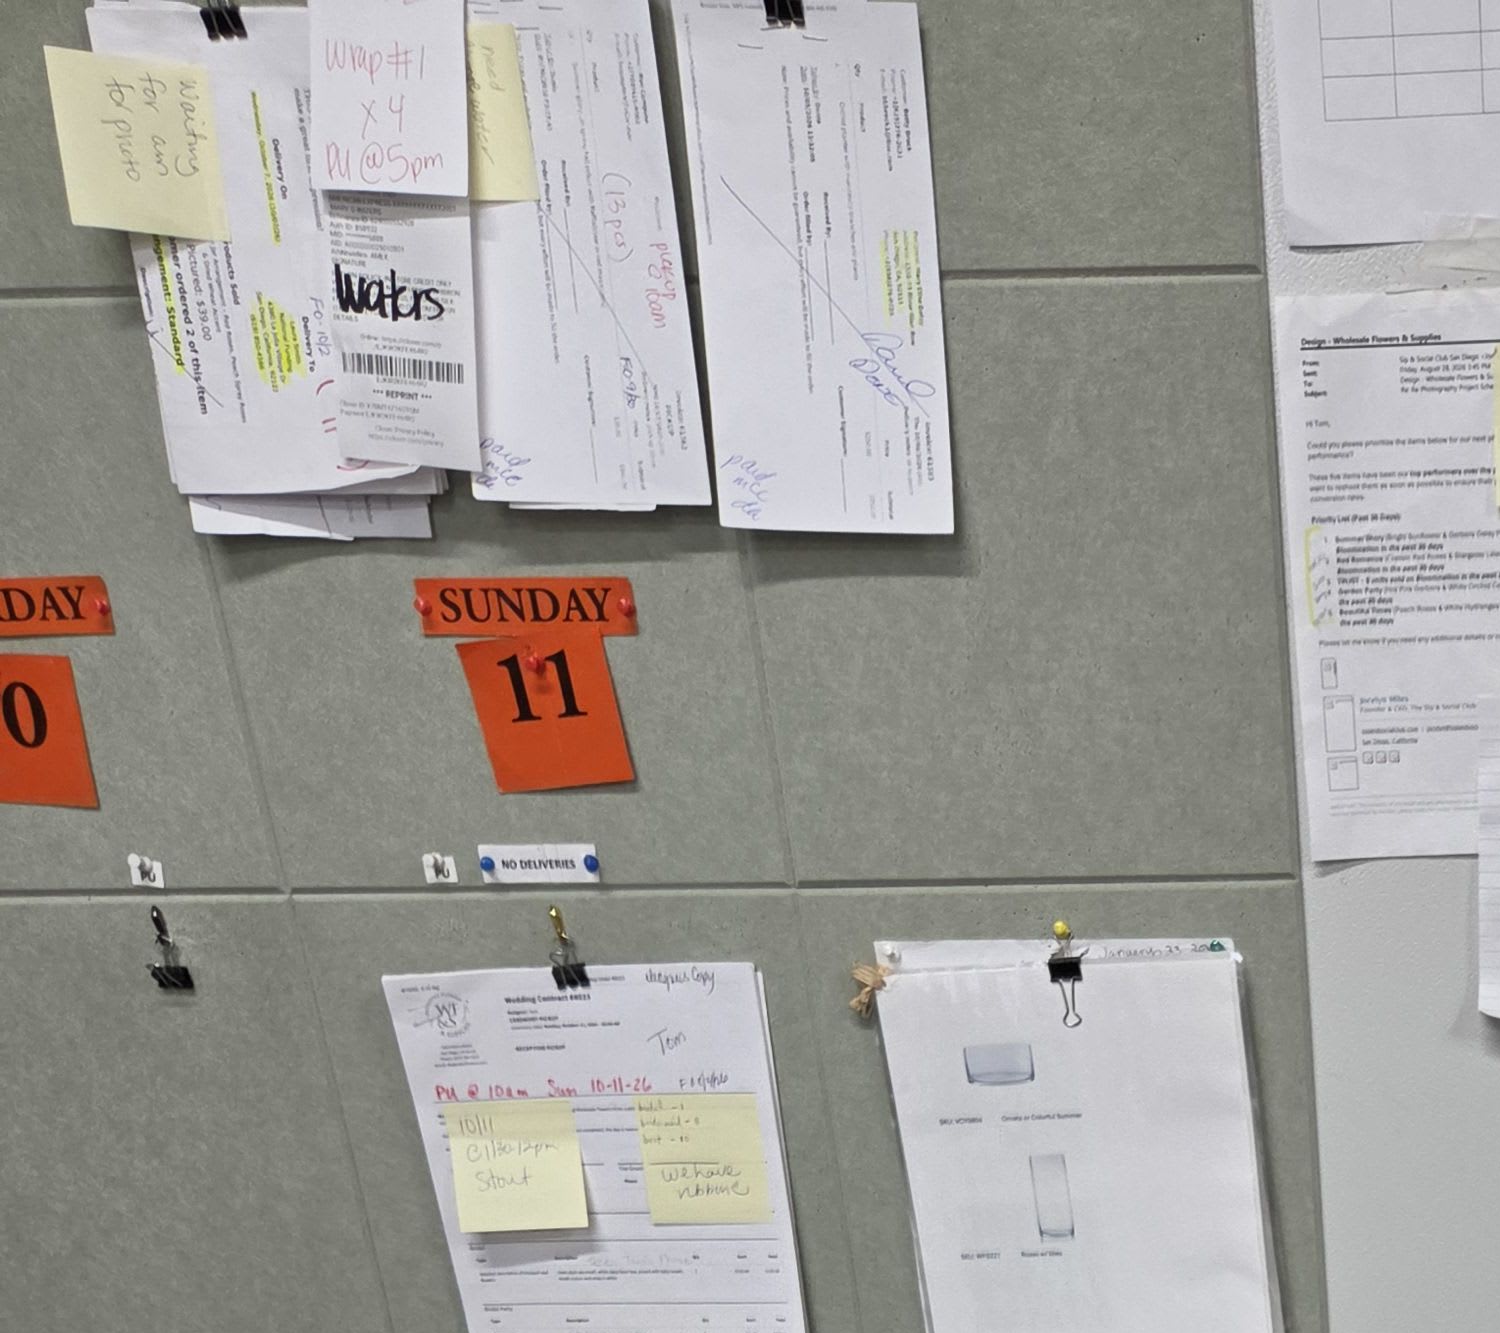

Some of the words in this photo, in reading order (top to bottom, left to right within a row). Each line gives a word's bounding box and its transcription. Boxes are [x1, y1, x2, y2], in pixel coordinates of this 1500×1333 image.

[272, 138, 285, 182] Delivery
[175, 272, 193, 324] ordered
[230, 283, 241, 305] Sold
[166, 306, 185, 366] Standard
[188, 340, 199, 354] of
[301, 315, 313, 357] Delivery
[1333, 336, 1370, 345] Wholesale
[1371, 335, 1400, 344] Flowers
[1410, 334, 1441, 343] Supplies
[192, 358, 204, 382] this
[196, 385, 209, 415] item
[0, 586, 86, 622] DAY
[439, 586, 612, 623] SUNDAY
[496, 649, 588, 724] 11
[1, 681, 48, 749] 0
[501, 859, 517, 870] NO
[519, 859, 576, 870] DELIVERIES
[504, 996, 537, 1005] Wedding
[590, 1076, 652, 1094] 10-11-26
[459, 1114, 494, 1136] 10/11
